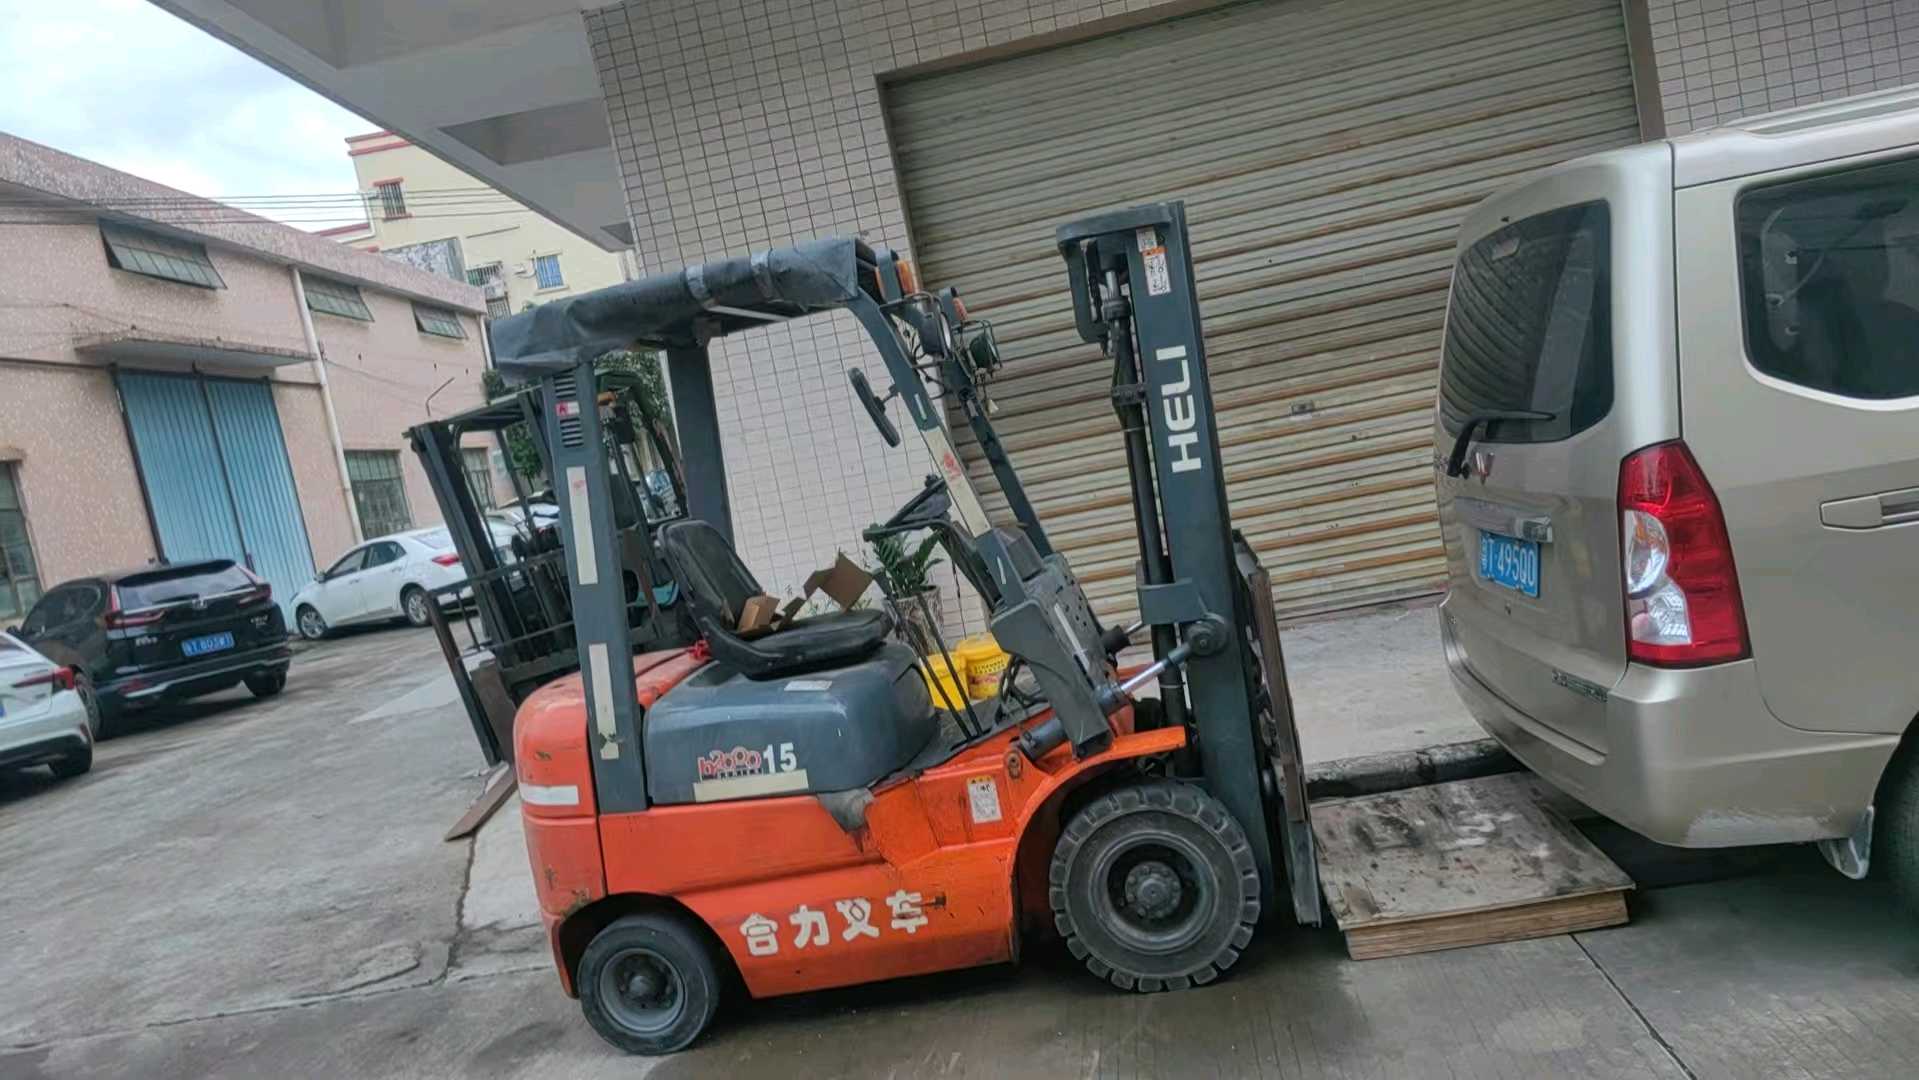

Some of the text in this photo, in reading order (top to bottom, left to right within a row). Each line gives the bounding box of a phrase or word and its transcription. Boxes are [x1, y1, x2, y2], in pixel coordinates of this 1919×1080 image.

[1155, 345, 1202, 473] HELI
[763, 742, 797, 774] 15
[739, 889, 929, 957] 合力叉车
